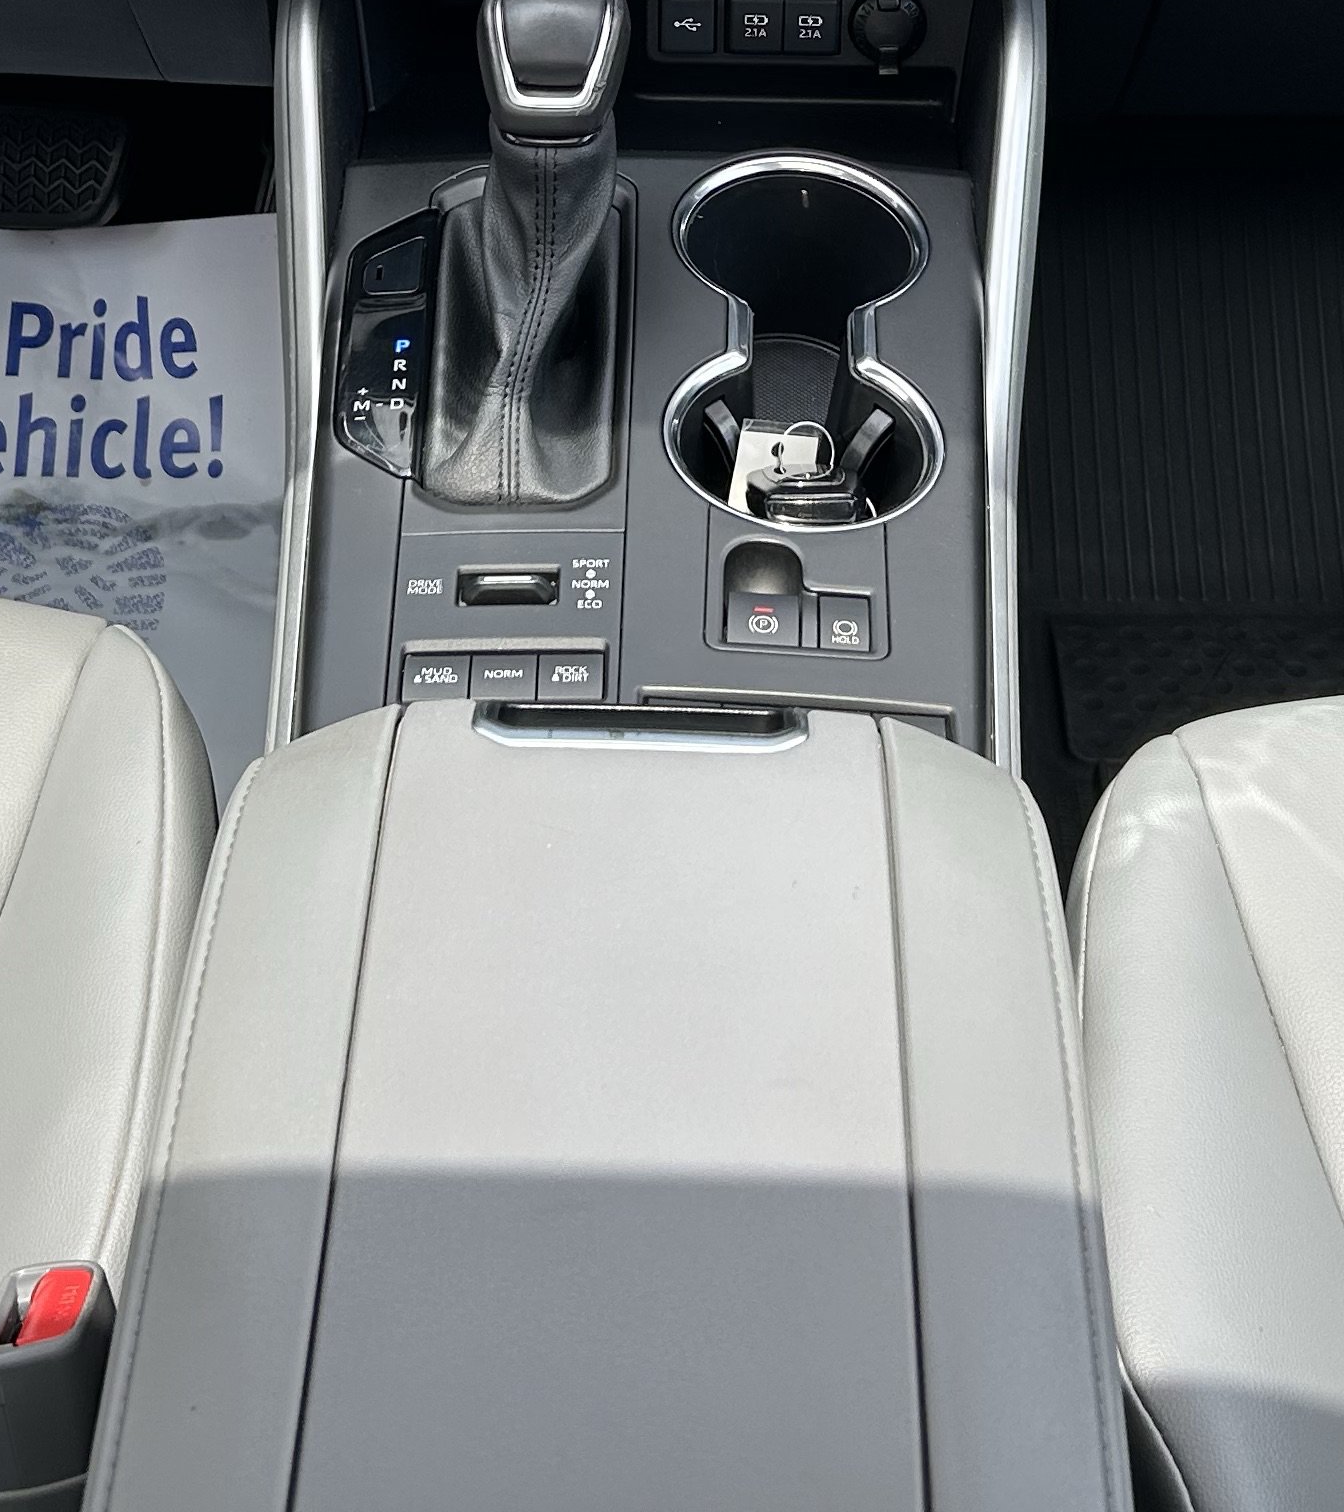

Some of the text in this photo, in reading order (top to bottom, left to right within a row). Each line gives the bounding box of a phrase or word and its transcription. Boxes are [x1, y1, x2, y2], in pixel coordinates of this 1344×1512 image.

[4, 295, 198, 382] Pride
[395, 340, 410, 352] P
[393, 359, 407, 372] R
[392, 379, 407, 390] N
[353, 398, 404, 413] M D
[572, 559, 610, 568] SPORT
[408, 579, 443, 588] DRIVE
[572, 580, 610, 588] NORM
[577, 600, 602, 609] ECO
[832, 636, 860, 645] HOLD
[421, 667, 453, 675] MUD
[484, 669, 523, 679] NORM
[555, 666, 587, 674] ROCK
[424, 675, 458, 684] SAND
[562, 673, 589, 683] DIRT
